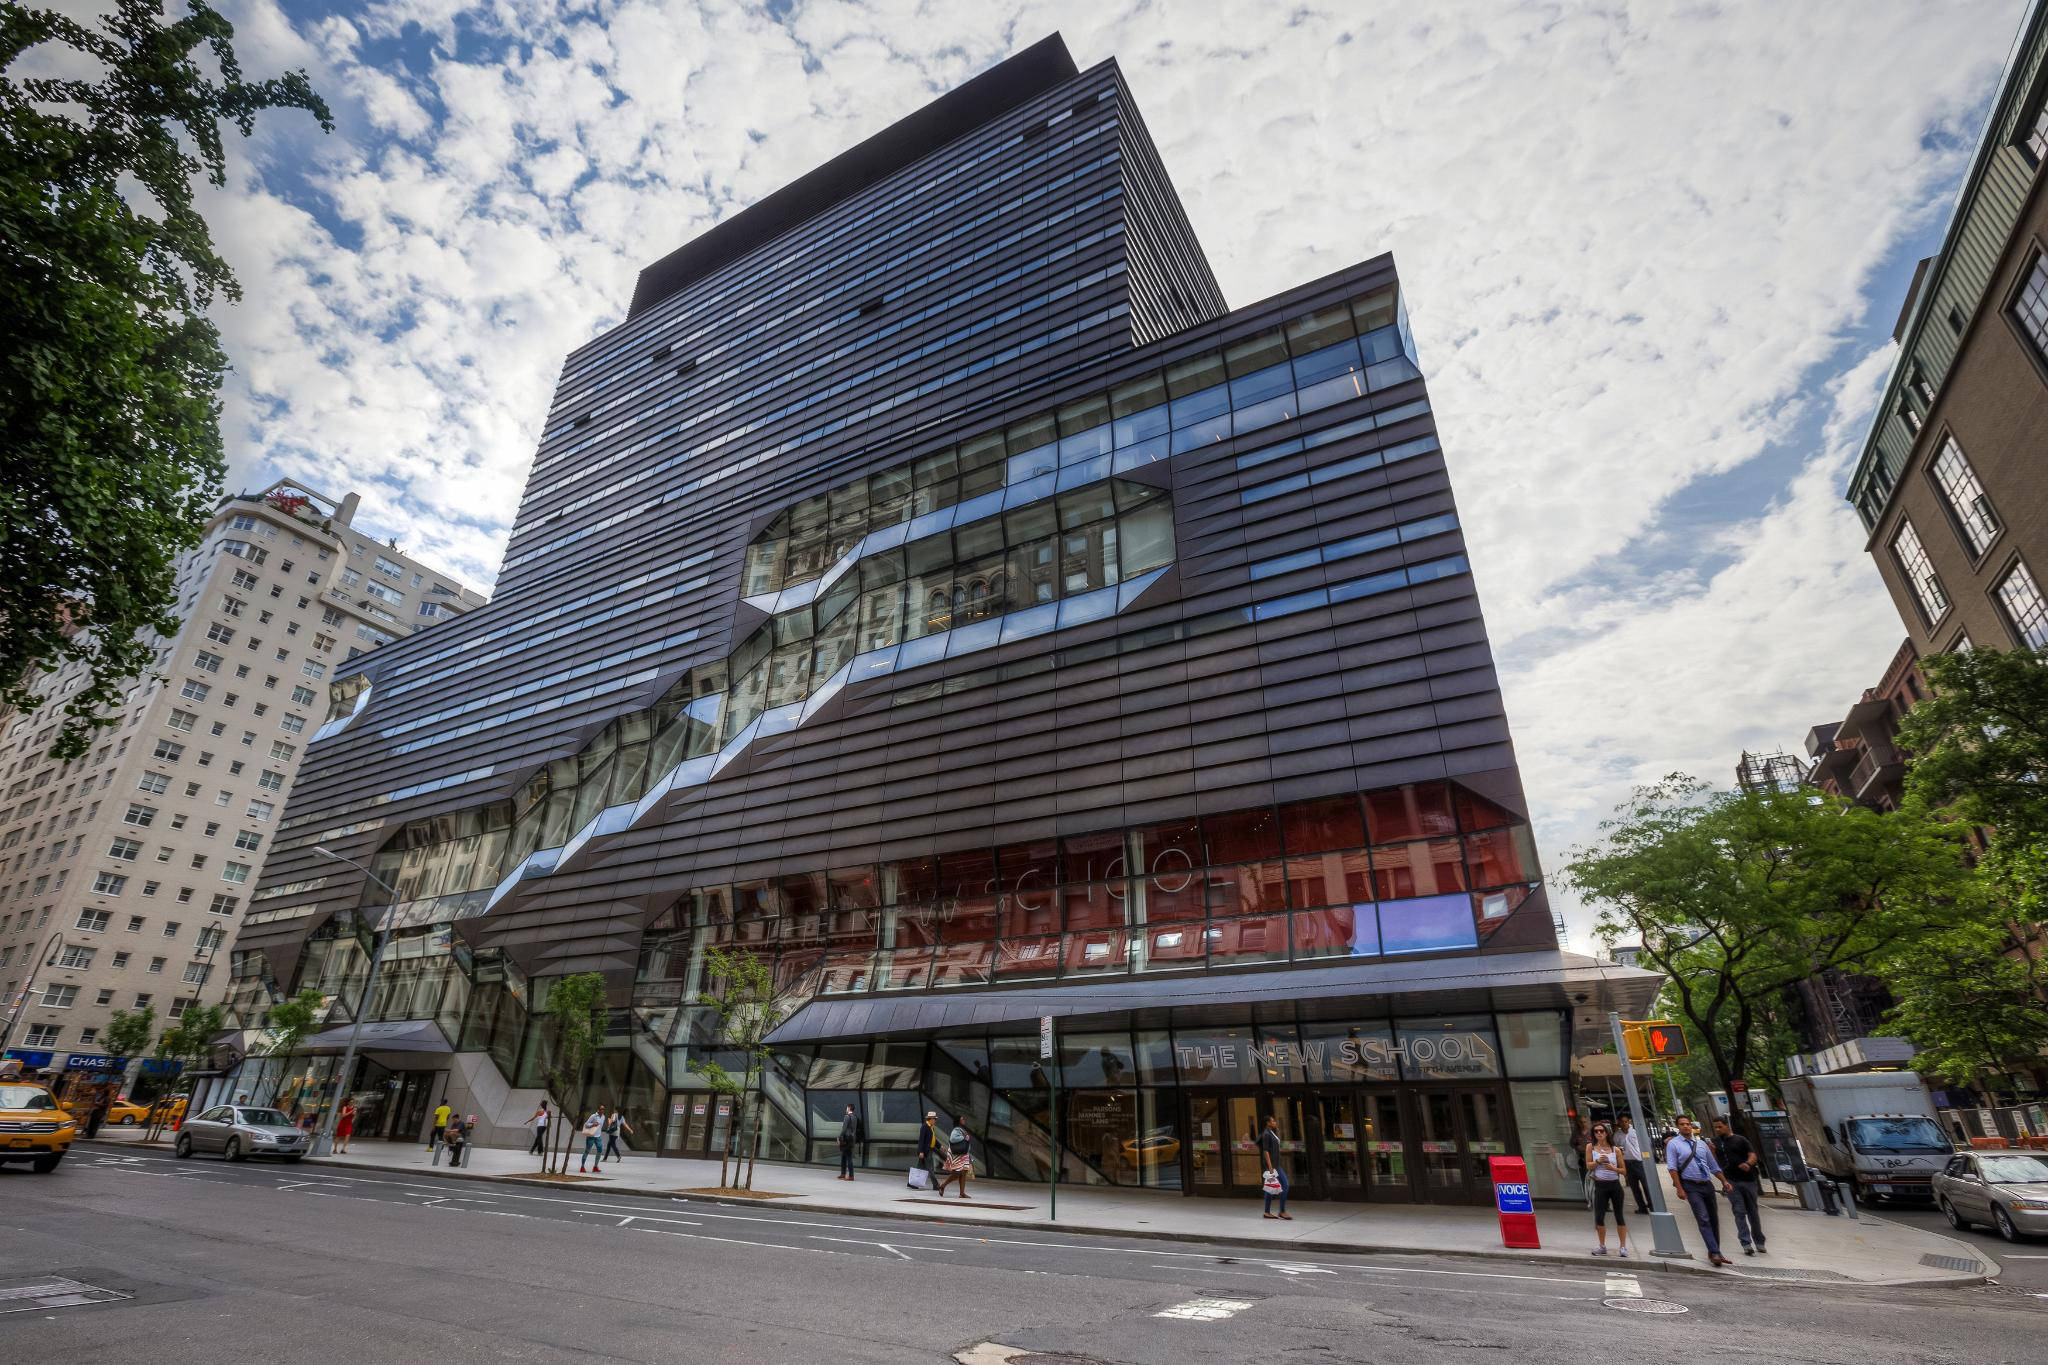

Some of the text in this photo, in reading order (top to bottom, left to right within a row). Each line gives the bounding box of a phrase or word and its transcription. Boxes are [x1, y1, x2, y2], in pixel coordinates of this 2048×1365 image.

[1175, 1035, 1488, 1070] THE NEW SCHOOL
[69, 1057, 113, 1068] CHASE
[1500, 1184, 1528, 1195] VOICE
